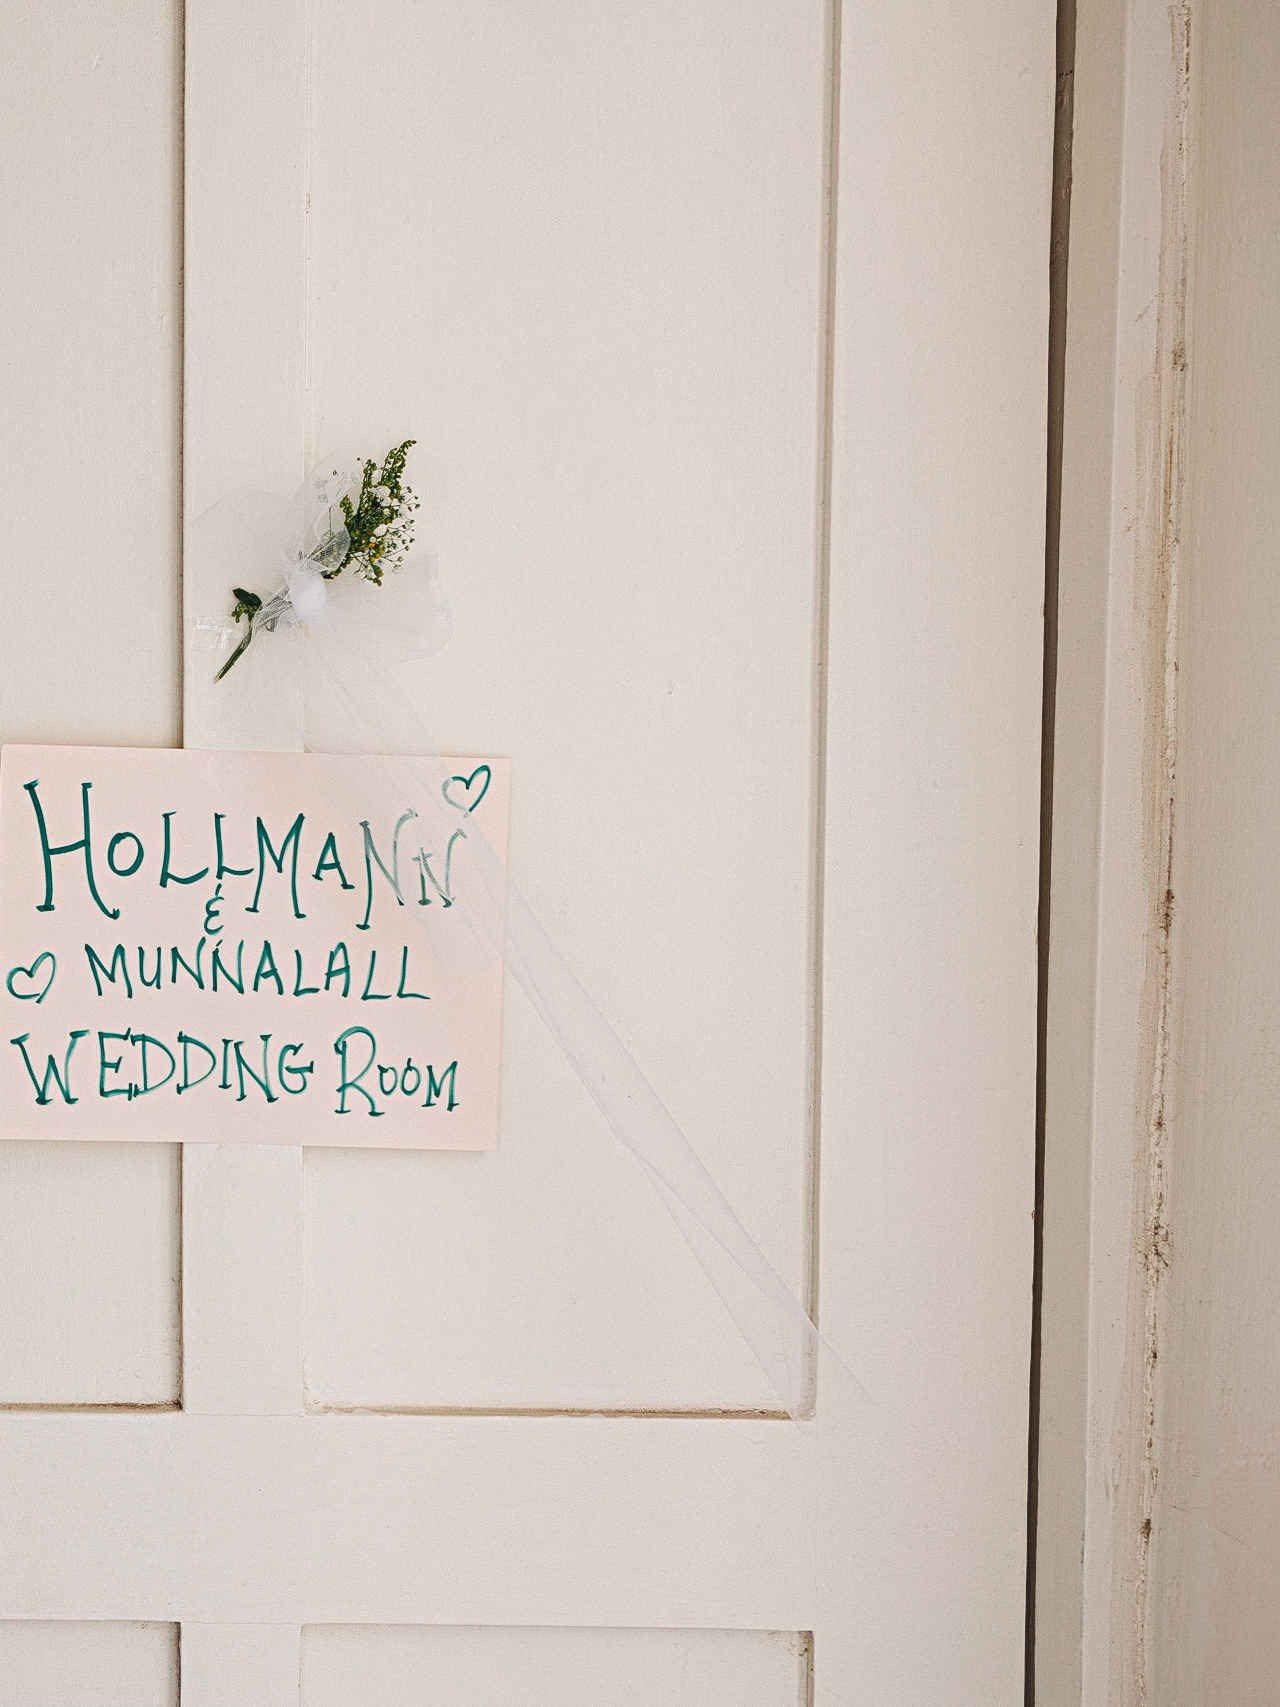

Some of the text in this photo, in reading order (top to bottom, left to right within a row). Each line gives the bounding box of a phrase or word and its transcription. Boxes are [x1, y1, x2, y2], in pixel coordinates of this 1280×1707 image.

[23, 777, 468, 931] HOLLMANN
[203, 881, 225, 949] &
[83, 936, 431, 1001] MUNNALALL
[9, 1025, 459, 1117] WEDDING ROOM
